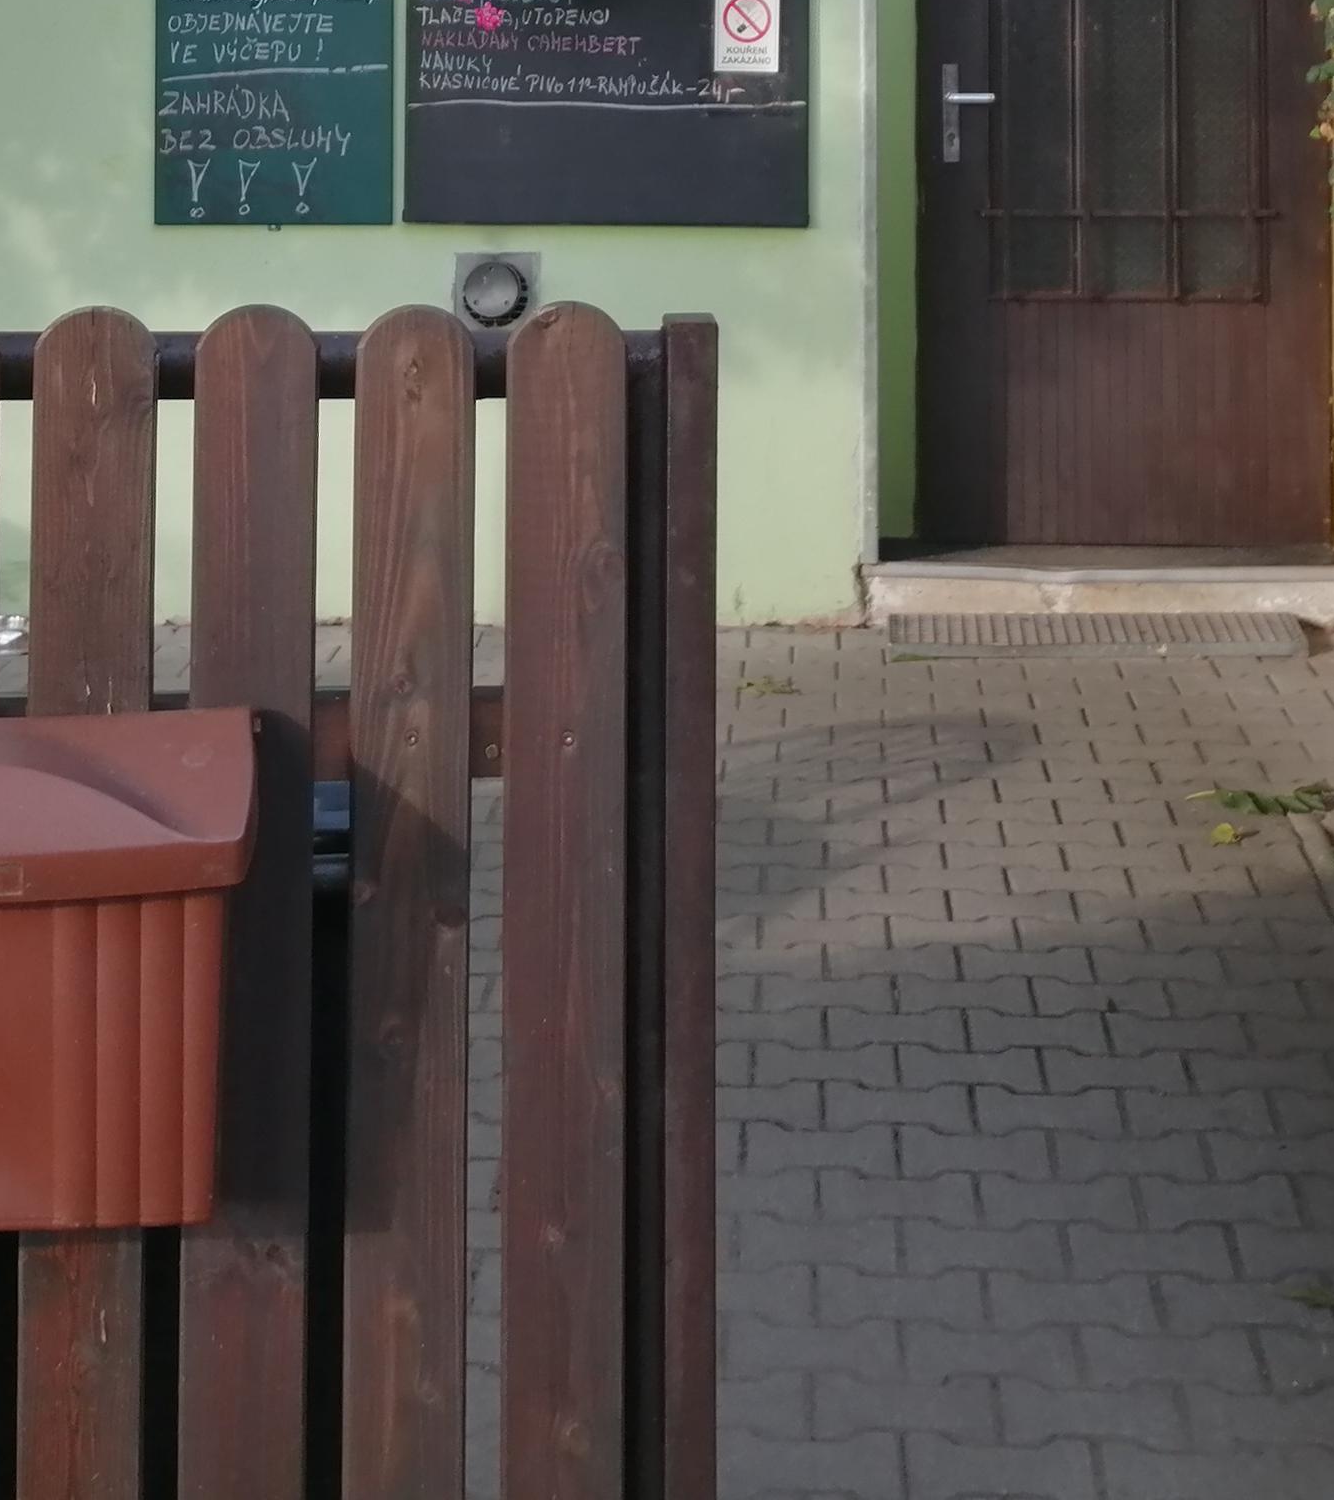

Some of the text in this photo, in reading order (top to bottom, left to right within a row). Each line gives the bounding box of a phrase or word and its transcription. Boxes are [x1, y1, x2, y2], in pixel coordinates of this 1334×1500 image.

[168, 9, 334, 34] OBJEDNÁVEJTE
[521, 7, 611, 27] UTOPENCI
[170, 41, 197, 64] VE
[213, 36, 302, 64] VÝČEPU
[158, 83, 290, 122] ZAHRÁDKA
[233, 123, 352, 156] OBSLUHY
